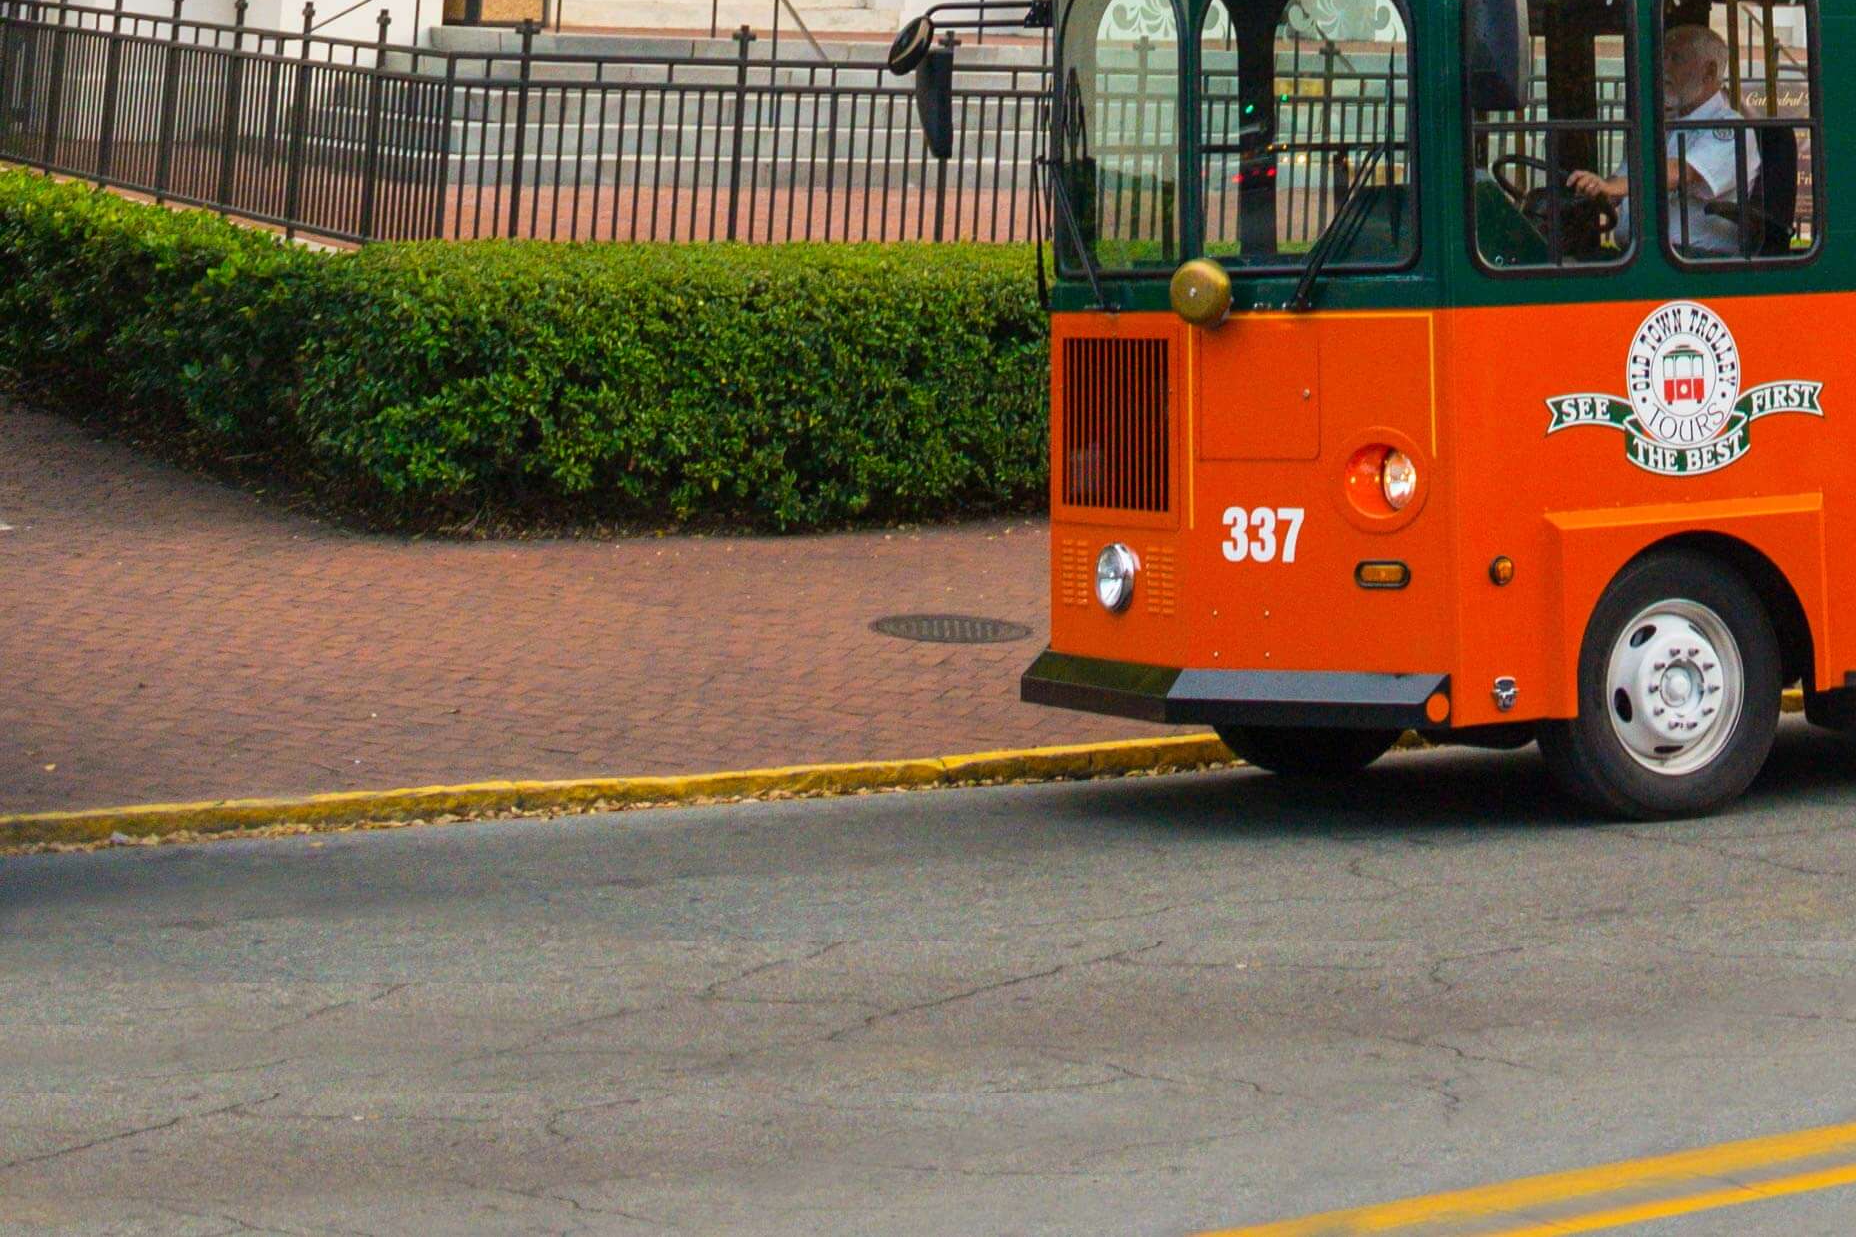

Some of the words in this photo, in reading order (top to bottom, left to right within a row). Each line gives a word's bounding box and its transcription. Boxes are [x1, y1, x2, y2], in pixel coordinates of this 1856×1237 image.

[1640, 307, 1682, 351] TOWN
[1688, 308, 1737, 386] TROLLEY
[1631, 355, 1651, 392] OLD
[1561, 397, 1611, 422] SEE
[1751, 386, 1815, 414] FIRST
[1649, 402, 1726, 443] TOURS
[1633, 437, 1679, 471] THE
[1686, 431, 1745, 471] BEST
[1222, 506, 1305, 564] 337
